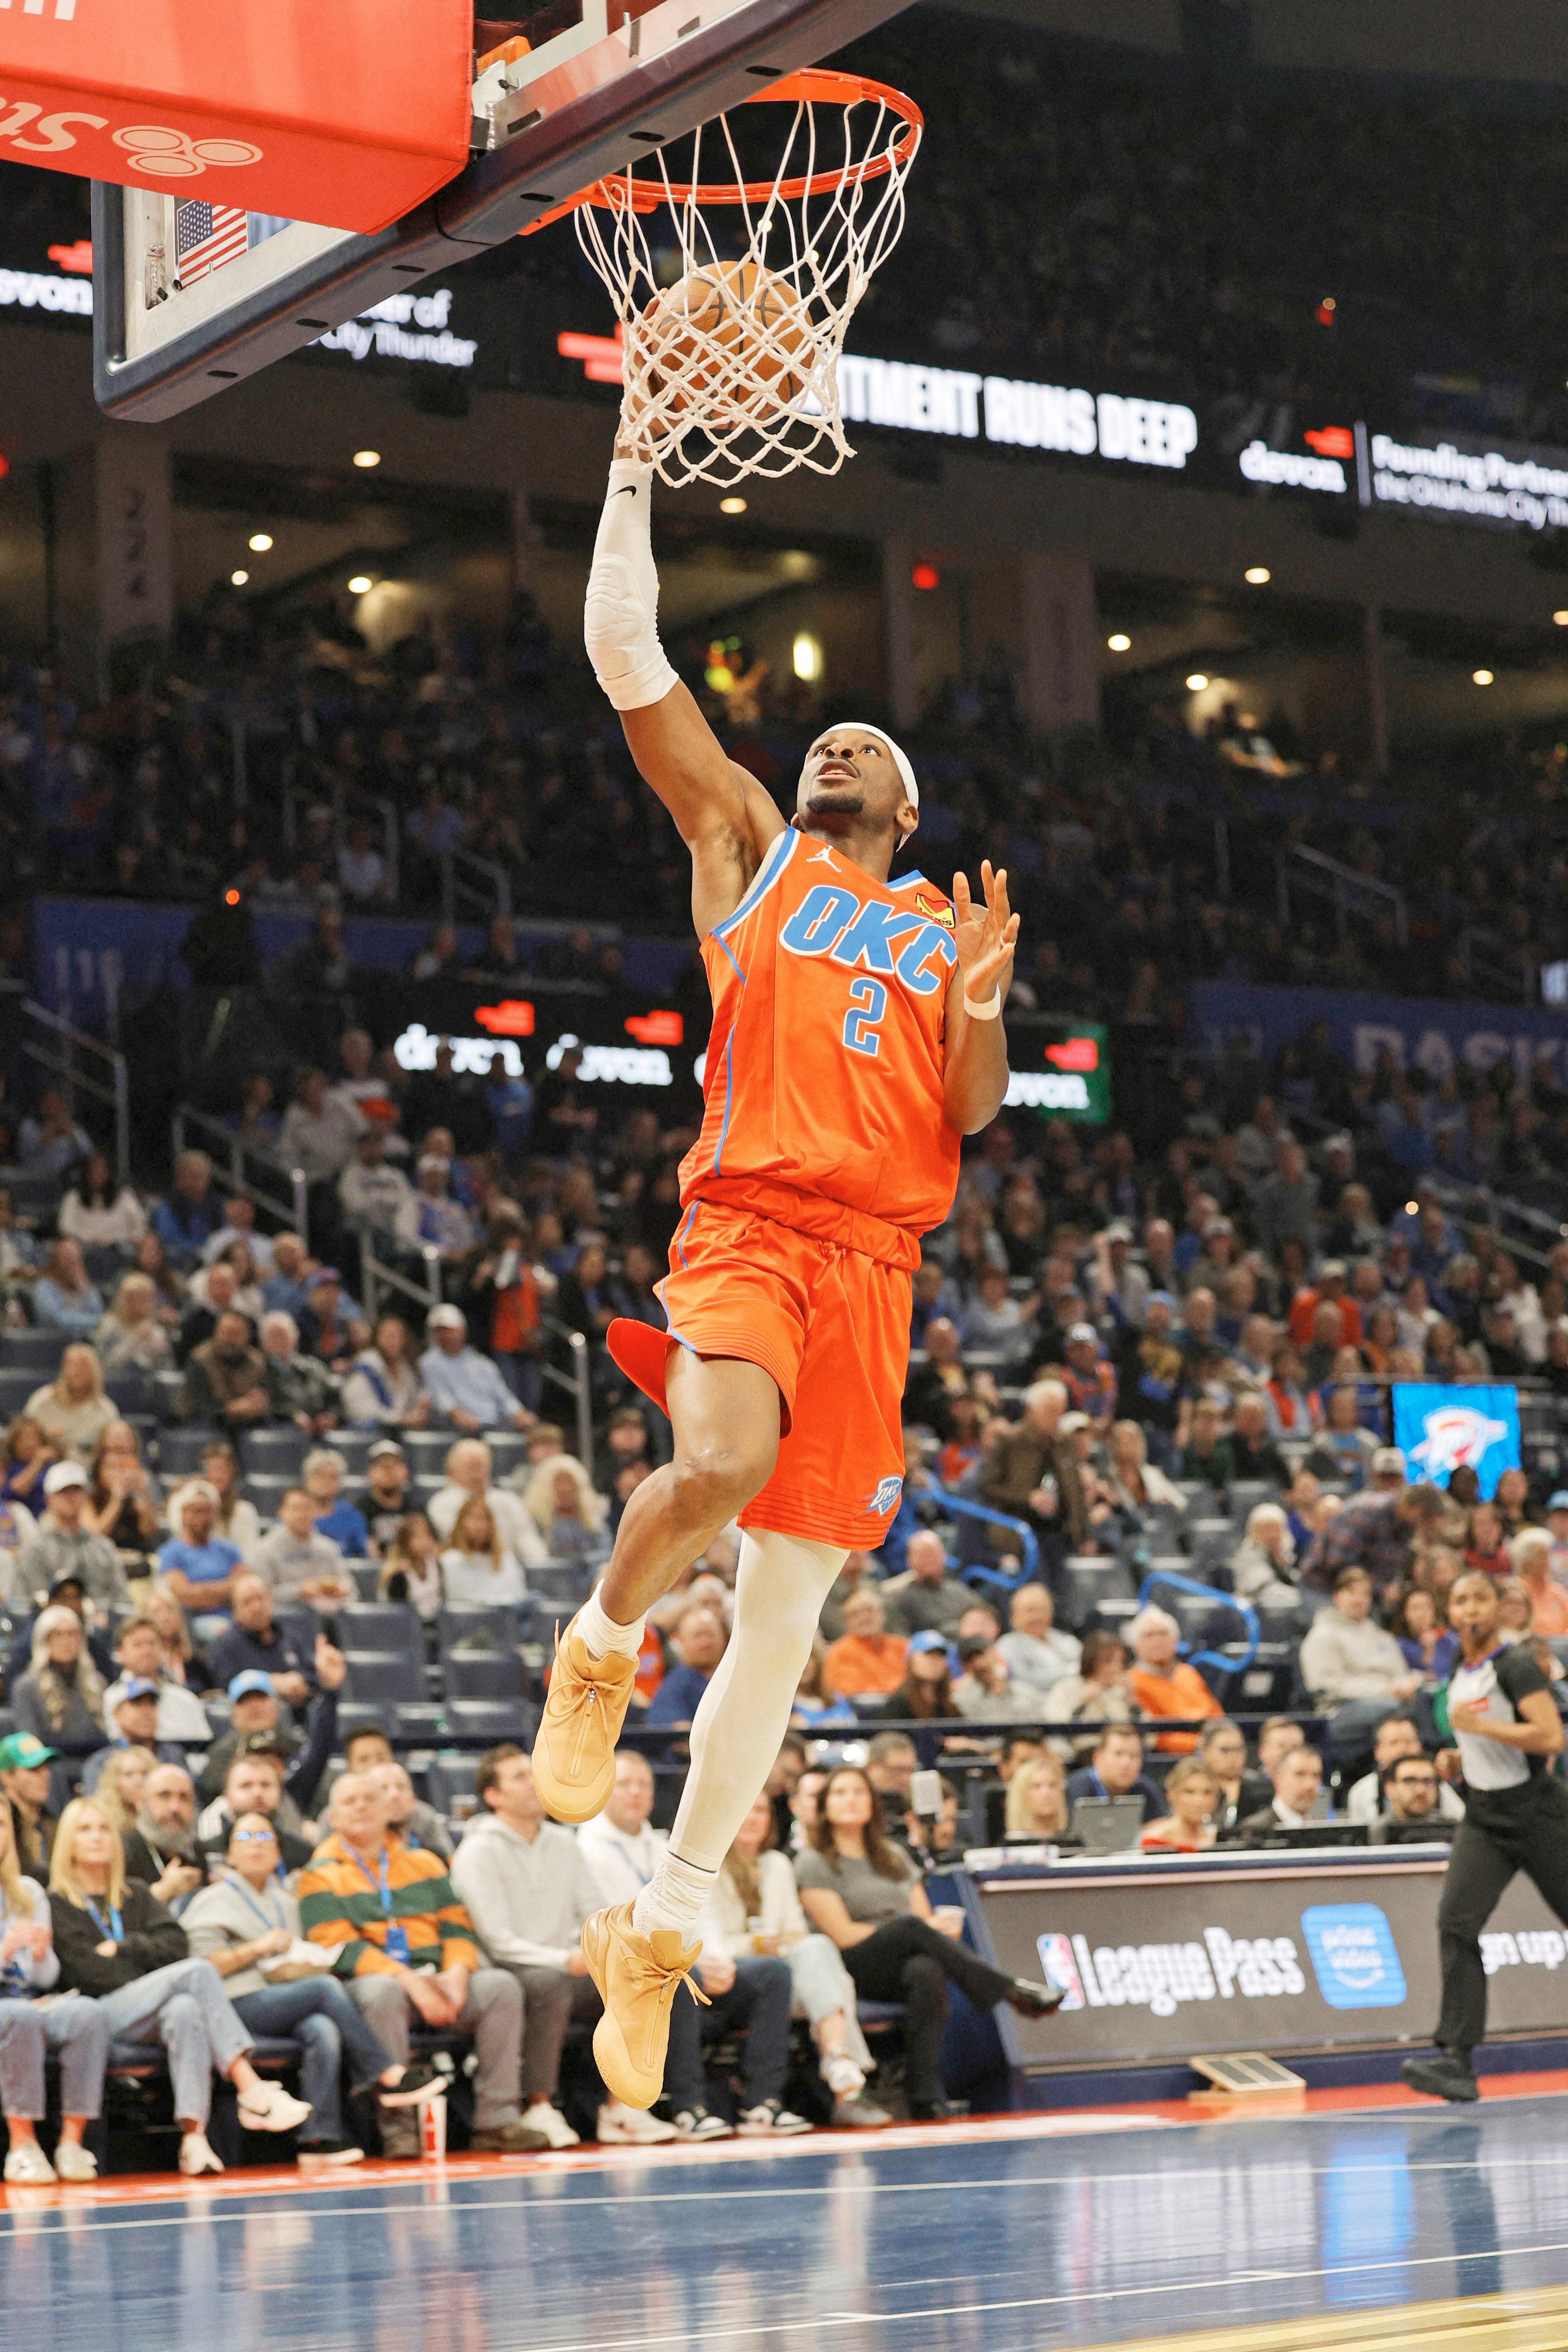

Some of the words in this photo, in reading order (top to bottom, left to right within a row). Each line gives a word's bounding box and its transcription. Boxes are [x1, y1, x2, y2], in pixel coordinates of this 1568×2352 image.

[0, 97, 110, 152] St
[984, 376, 1097, 455] RUNS
[1097, 393, 1198, 469] DEEP
[779, 885, 958, 996] OKC
[842, 977, 888, 1058] 2
[1072, 1934, 1216, 2017] League
[1203, 1927, 1306, 1998] Pass
